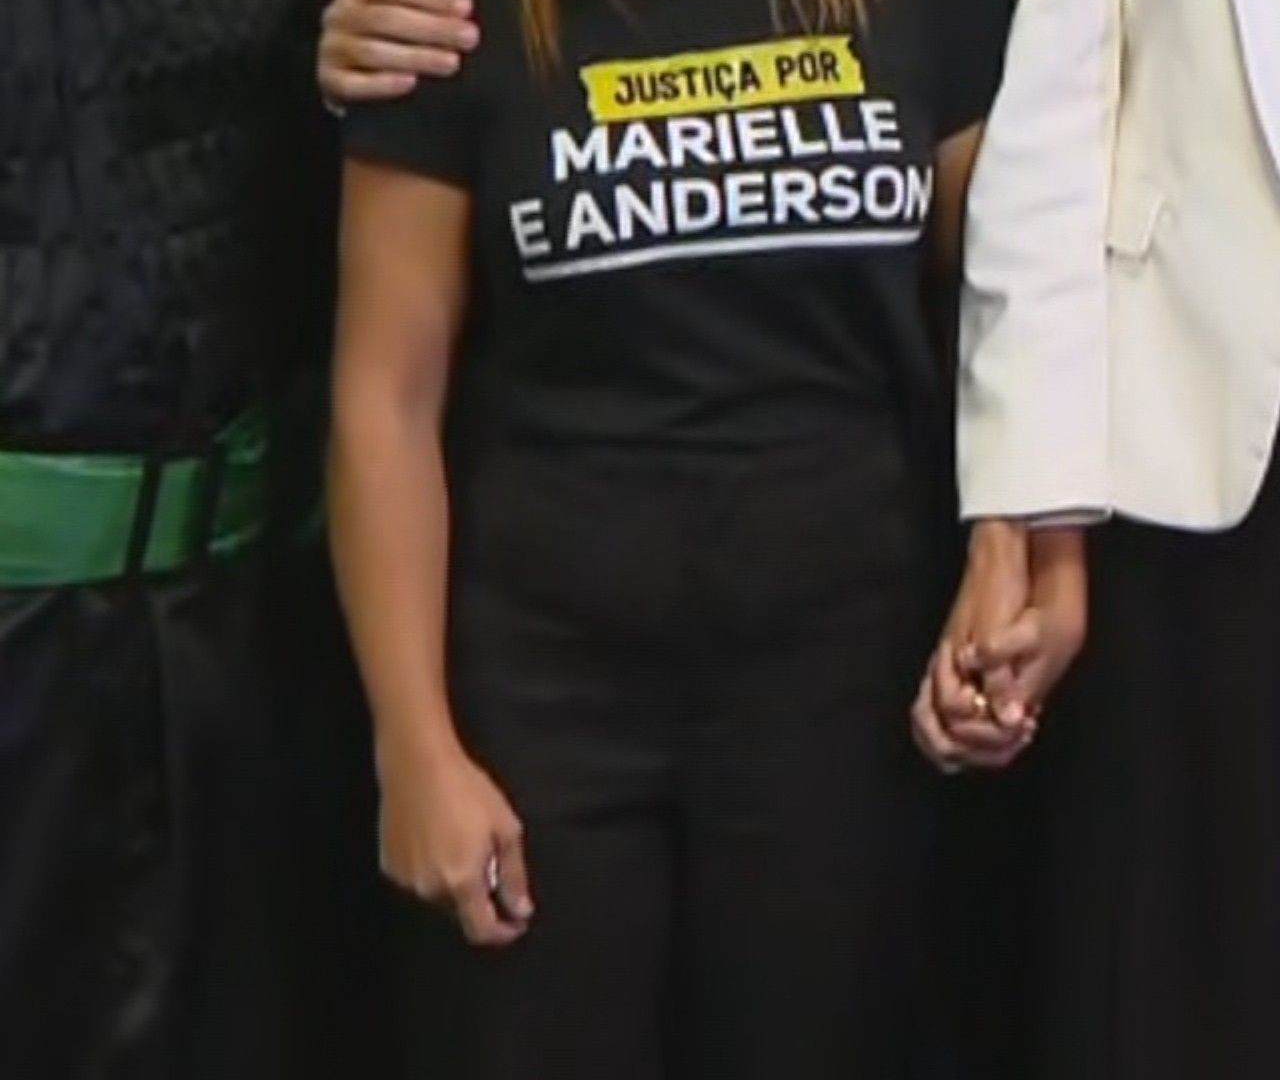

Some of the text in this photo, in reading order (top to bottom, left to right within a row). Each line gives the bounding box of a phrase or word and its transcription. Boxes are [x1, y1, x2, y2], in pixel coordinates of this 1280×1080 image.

[614, 49, 841, 106] JUSTIÇA POR
[550, 100, 902, 184] MARIELLE
[510, 163, 934, 260] E ANDERSON
